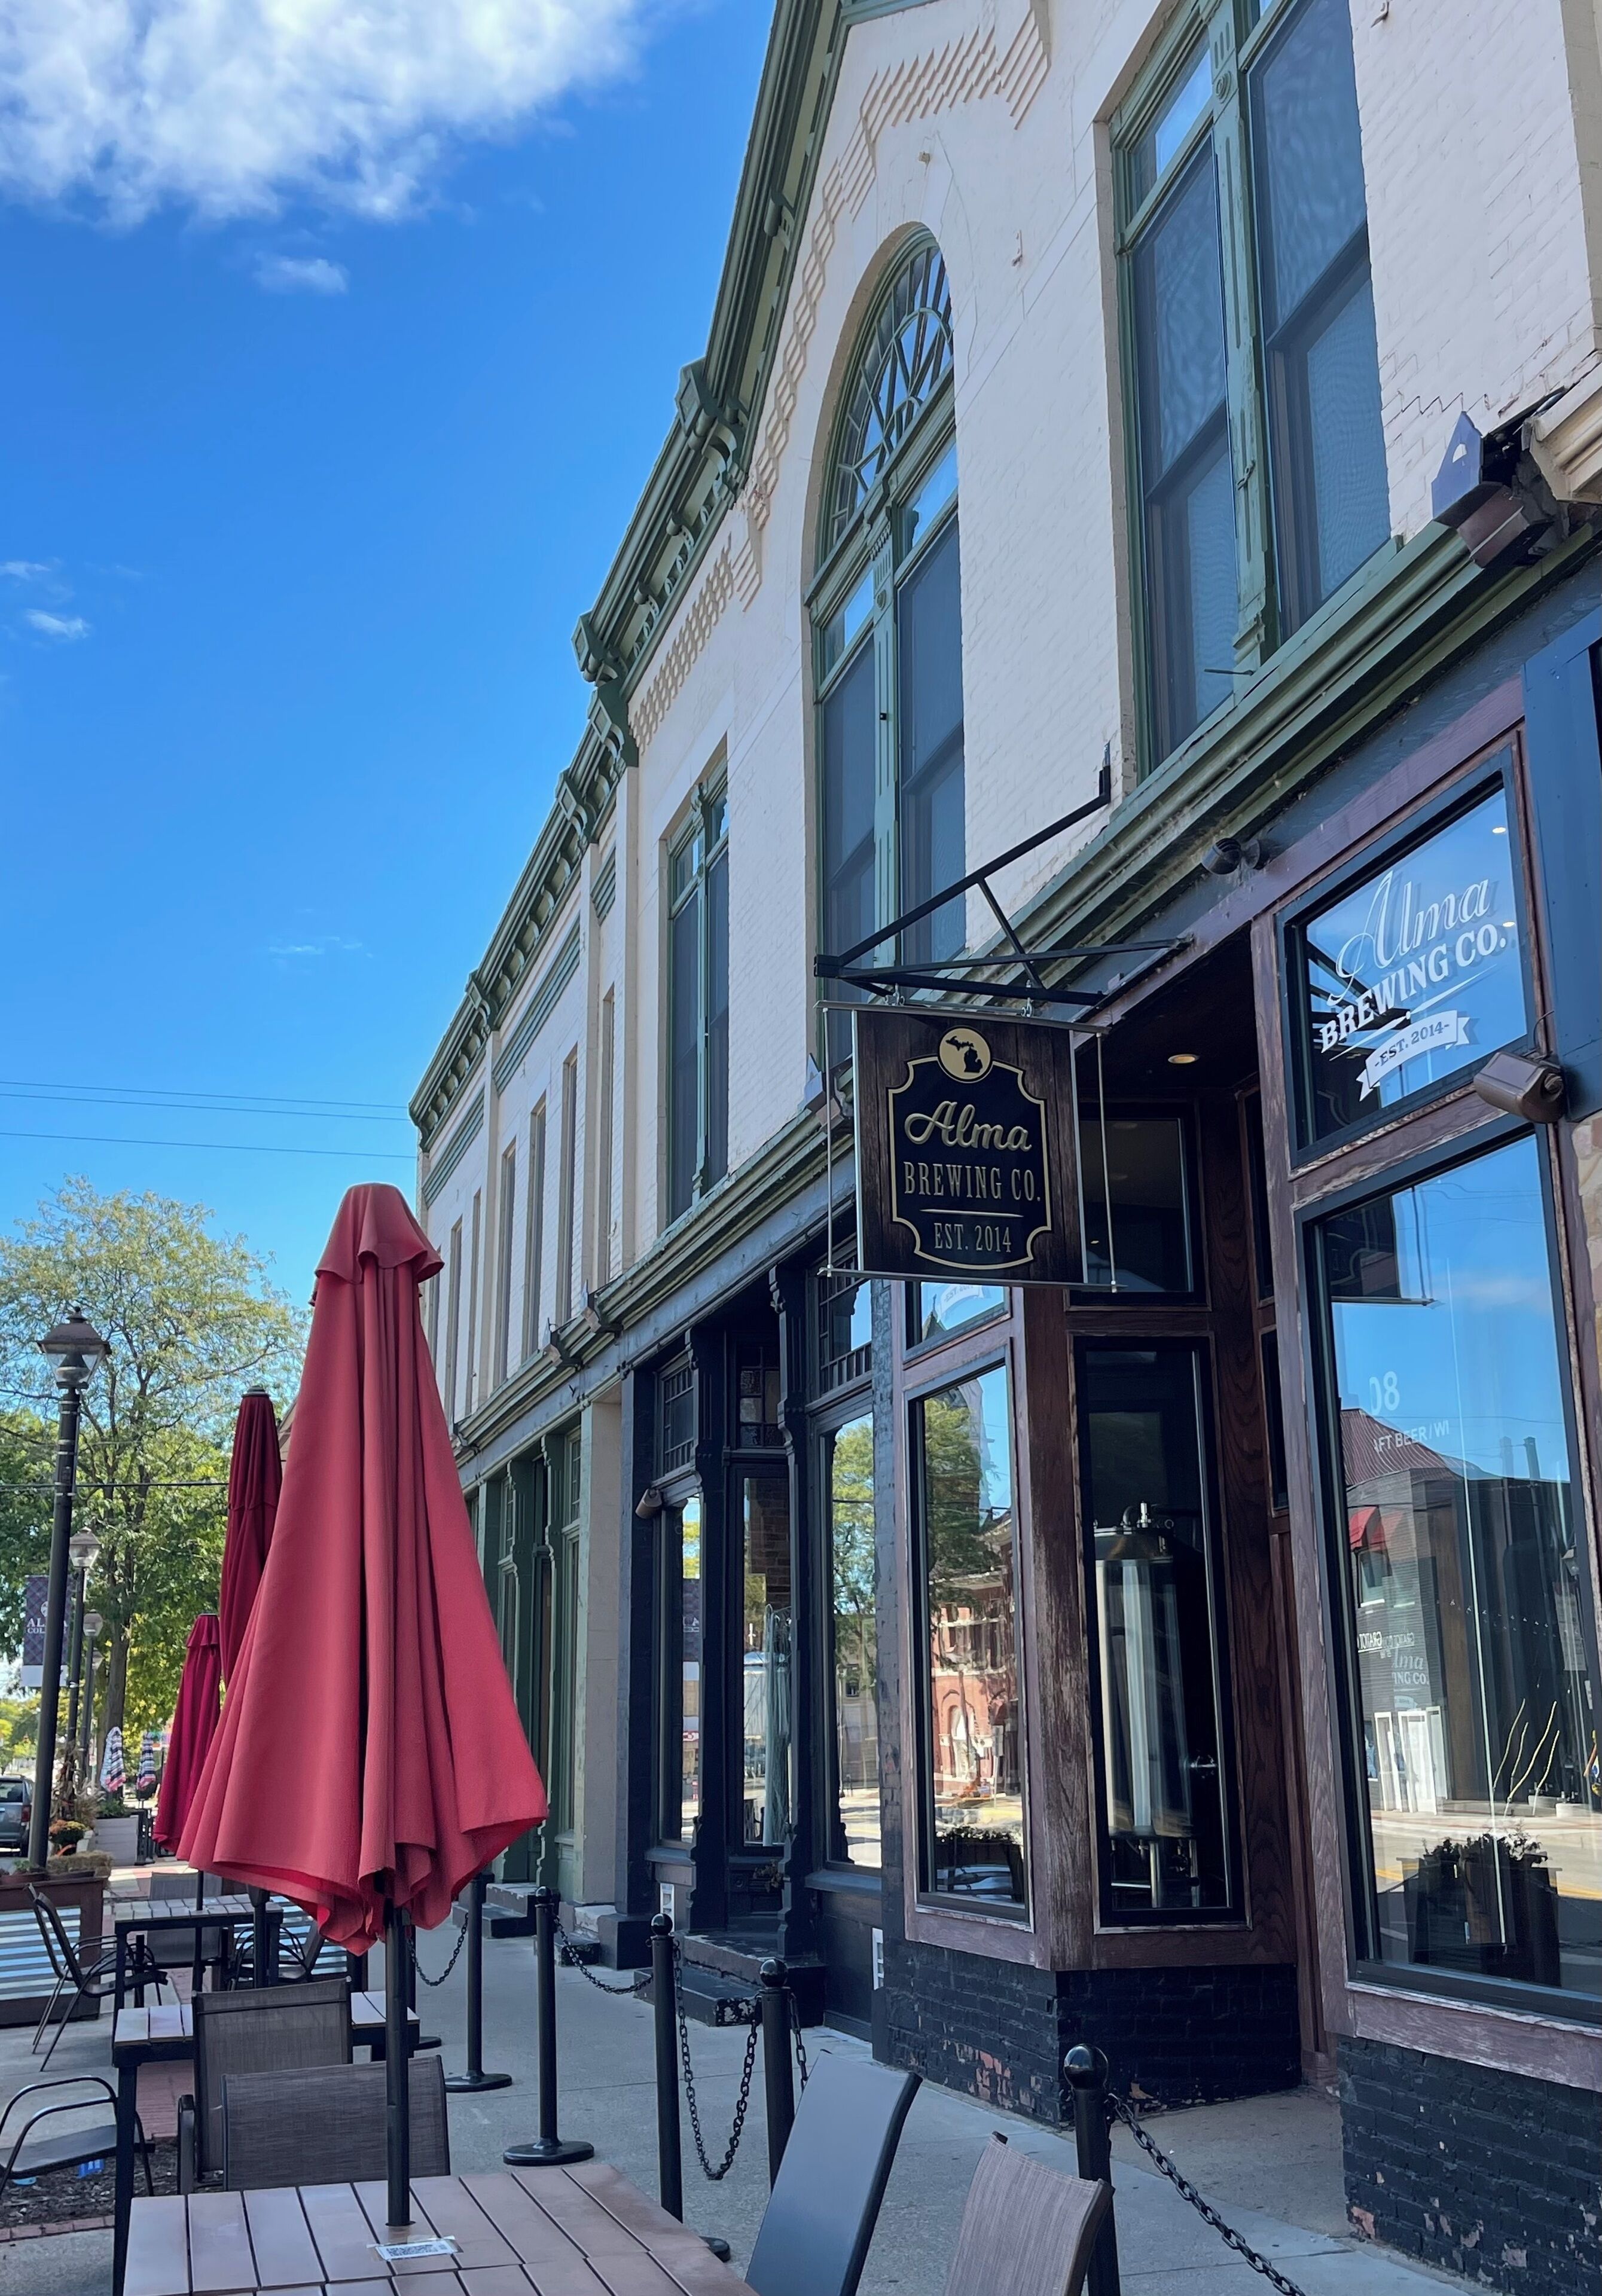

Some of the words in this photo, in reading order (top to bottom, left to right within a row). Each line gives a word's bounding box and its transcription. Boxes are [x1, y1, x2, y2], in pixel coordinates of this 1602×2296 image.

[1327, 871, 1489, 1006] Alma
[1320, 943, 1449, 1053] BREWING
[1455, 924, 1506, 967] CO.
[904, 1101, 1032, 1152] Alma
[904, 1162, 1002, 1199] BREWING
[1011, 1168, 1041, 1202] CO.
[934, 1223, 969, 1250] EST.
[975, 1225, 1012, 1253] 2014
